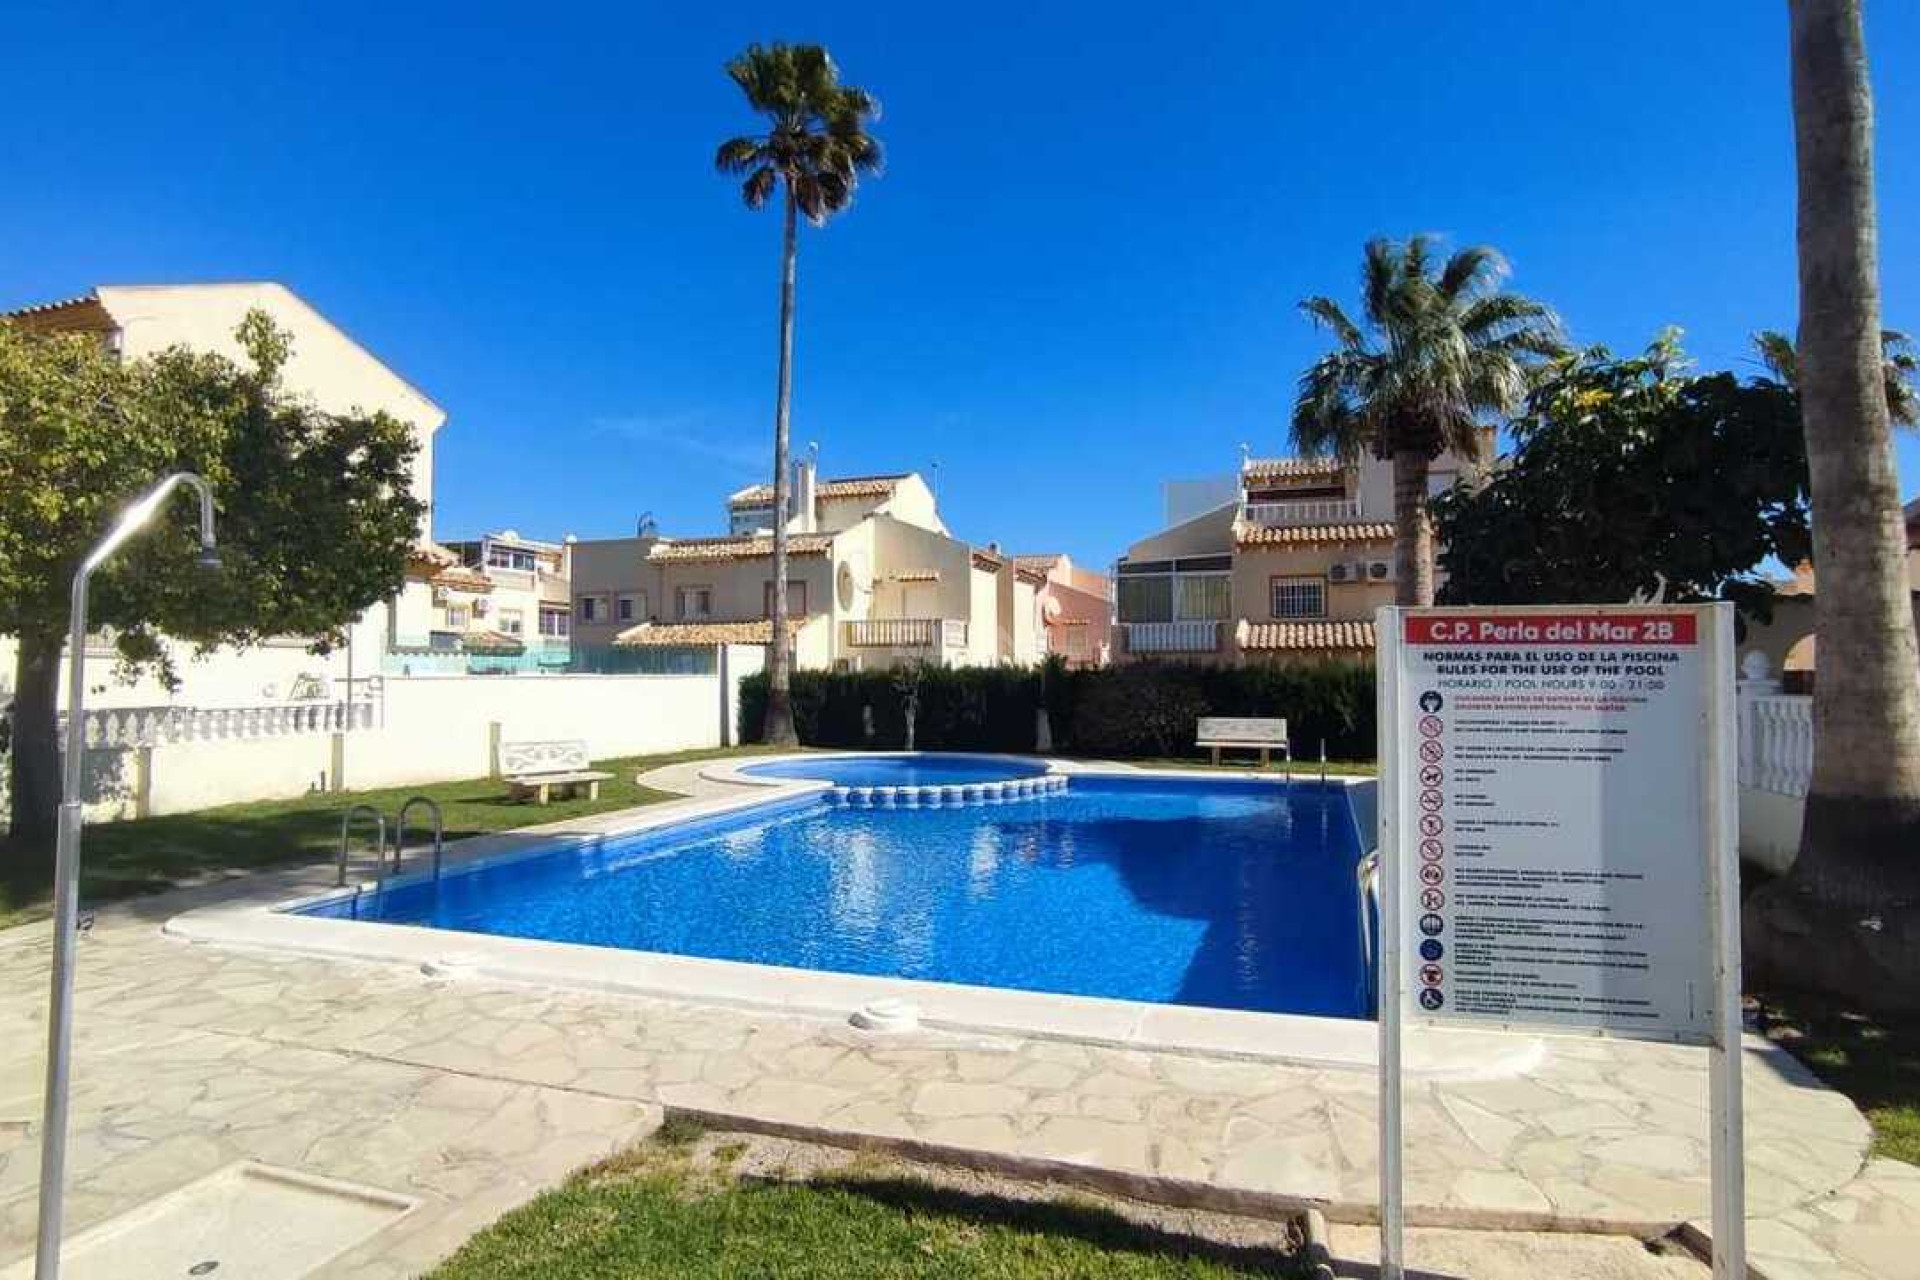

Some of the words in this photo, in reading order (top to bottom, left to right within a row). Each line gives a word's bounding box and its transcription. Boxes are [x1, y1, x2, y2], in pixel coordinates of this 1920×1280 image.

[1430, 622, 1472, 640] C.P.
[1479, 622, 1539, 640] Perla
[1546, 621, 1582, 640] del
[1589, 622, 1637, 640] Mar
[1643, 622, 1674, 640] 2B
[1423, 651, 1482, 662] NORMAS
[1486, 651, 1522, 662] PARA
[1526, 652, 1541, 662] EL
[1544, 652, 1573, 662] USO
[1578, 652, 1596, 662] DE
[1600, 652, 1618, 662] LA
[1621, 652, 1680, 663] PISCINA
[1436, 665, 1477, 675] RULES
[1481, 665, 1508, 675] FOR
[1512, 665, 1537, 675] THE
[1541, 665, 1568, 675] USE
[1571, 665, 1589, 675] OF
[1595, 665, 1620, 676] THE
[1625, 665, 1665, 676] POOL
[1505, 679, 1537, 689] POOL
[1541, 679, 1586, 689] HOURS
